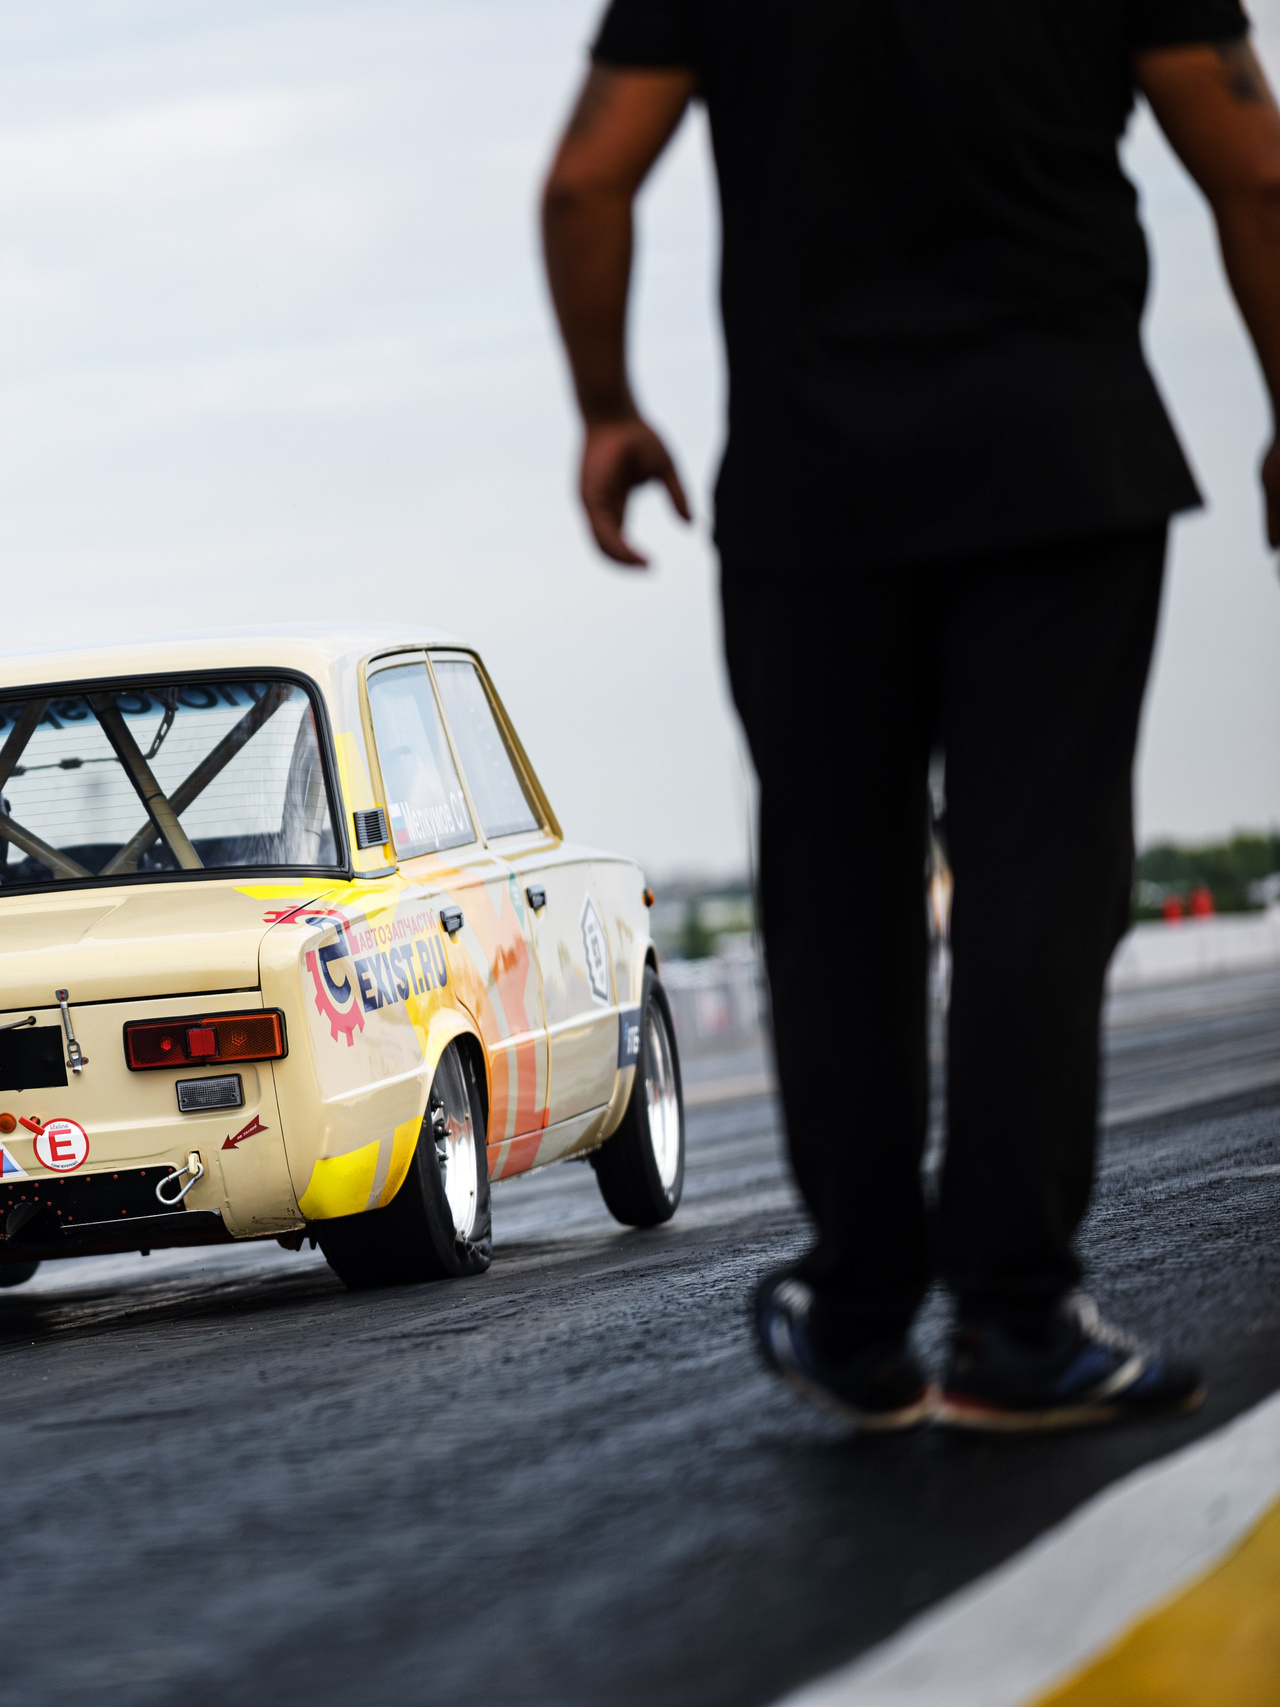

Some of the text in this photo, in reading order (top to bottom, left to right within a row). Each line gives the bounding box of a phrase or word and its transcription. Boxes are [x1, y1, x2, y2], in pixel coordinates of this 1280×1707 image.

[359, 911, 437, 952] АВТОЗАПЧАСТИ
[354, 935, 447, 1013] EXIST.RU
[48, 1129, 76, 1161] E
